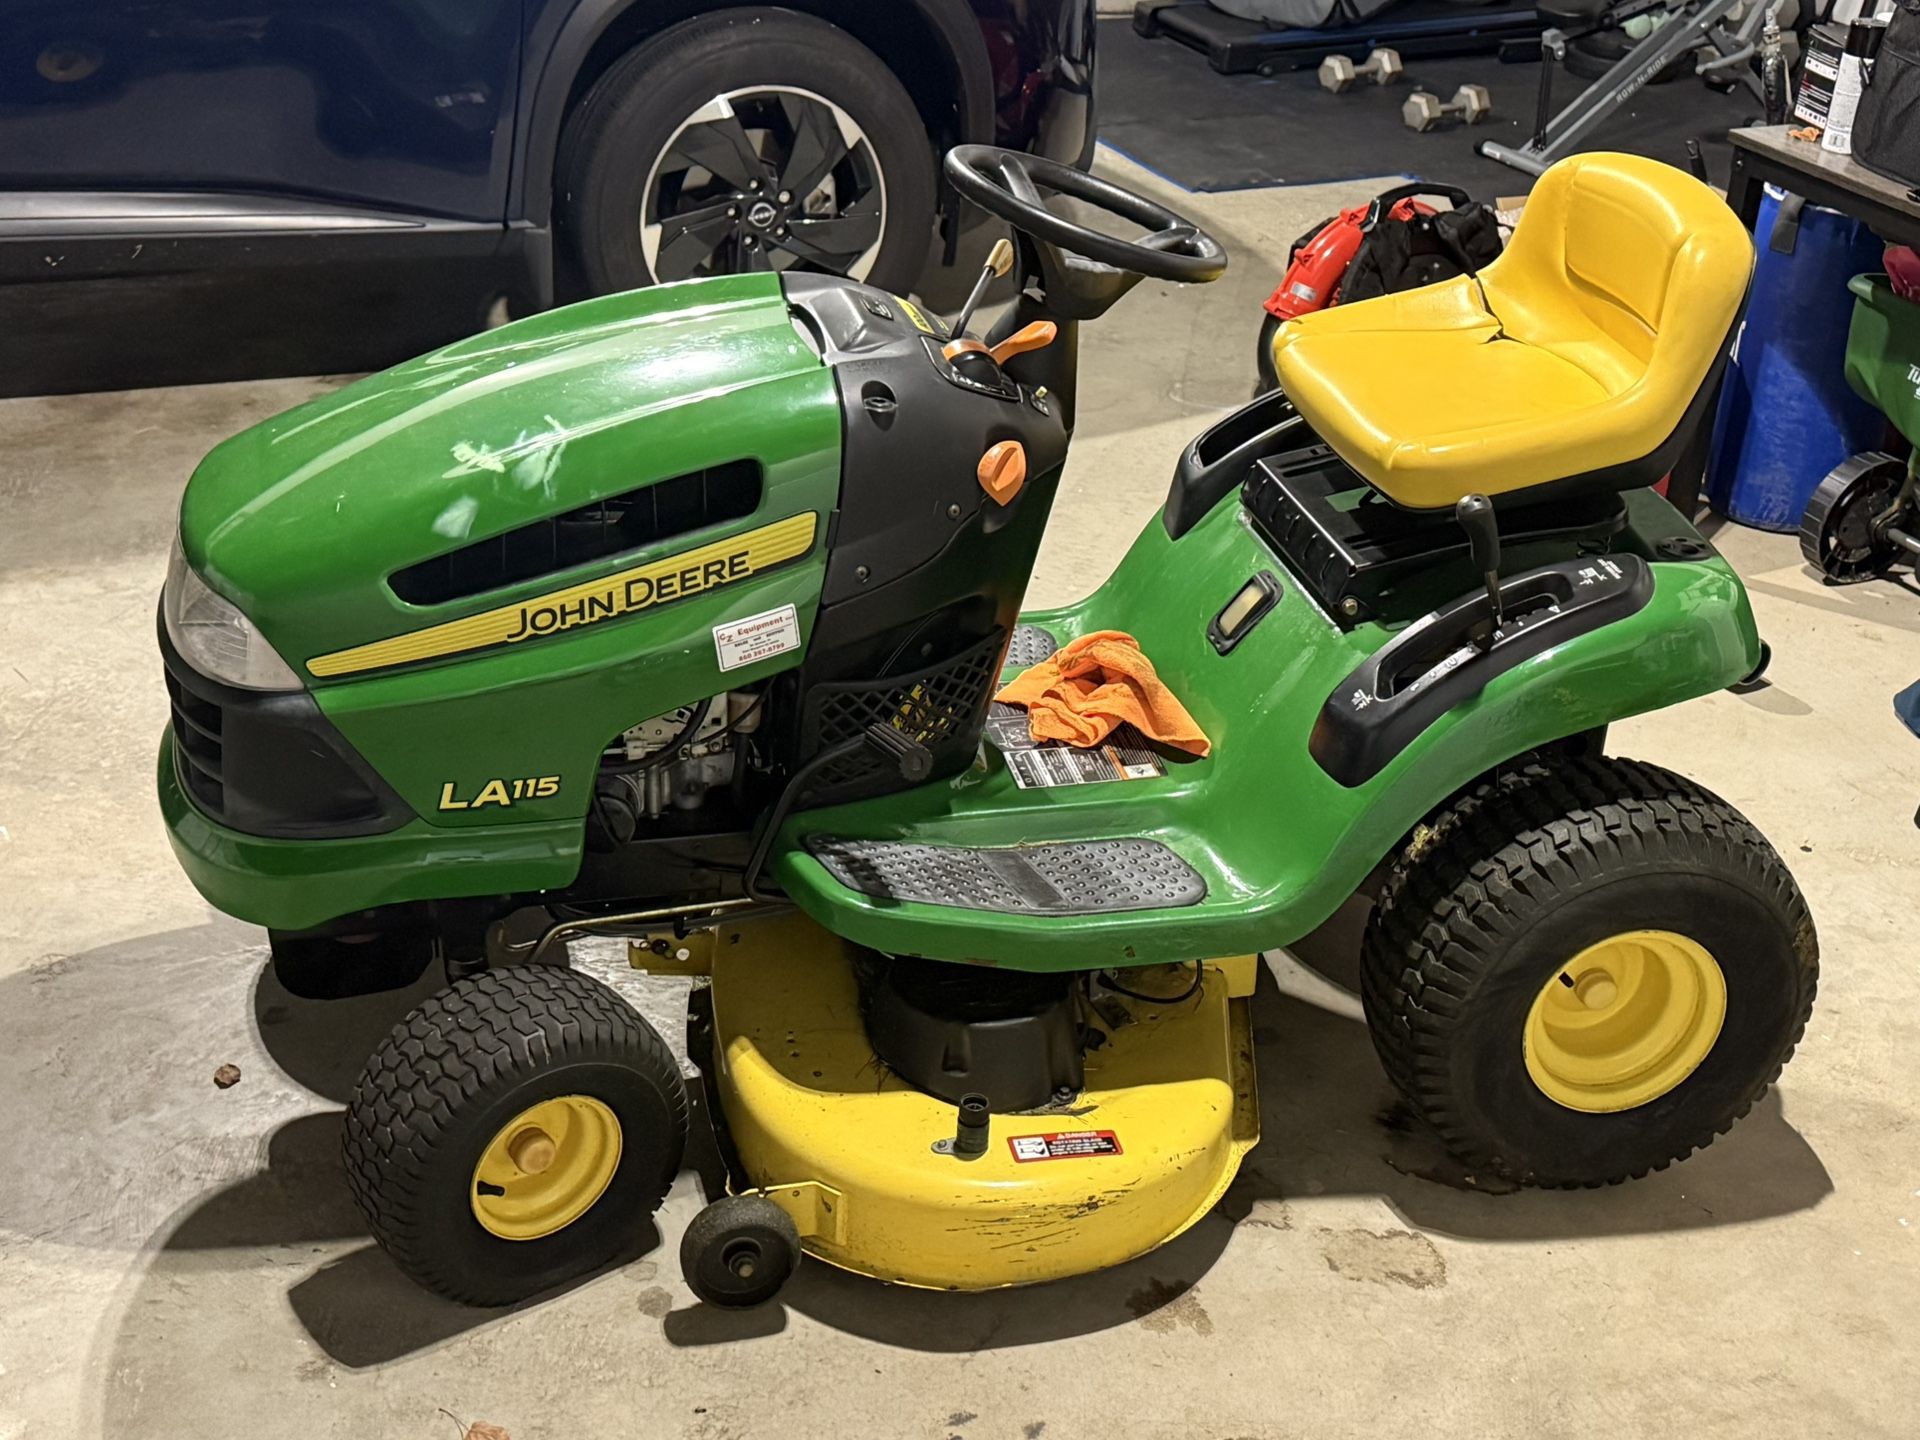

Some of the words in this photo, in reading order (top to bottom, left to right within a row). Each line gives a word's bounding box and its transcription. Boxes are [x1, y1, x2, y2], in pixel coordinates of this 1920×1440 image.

[507, 591, 614, 639] JOHN
[625, 551, 750, 608] DEERE
[737, 616, 783, 636] Equipment
[439, 776, 560, 810] LA115
